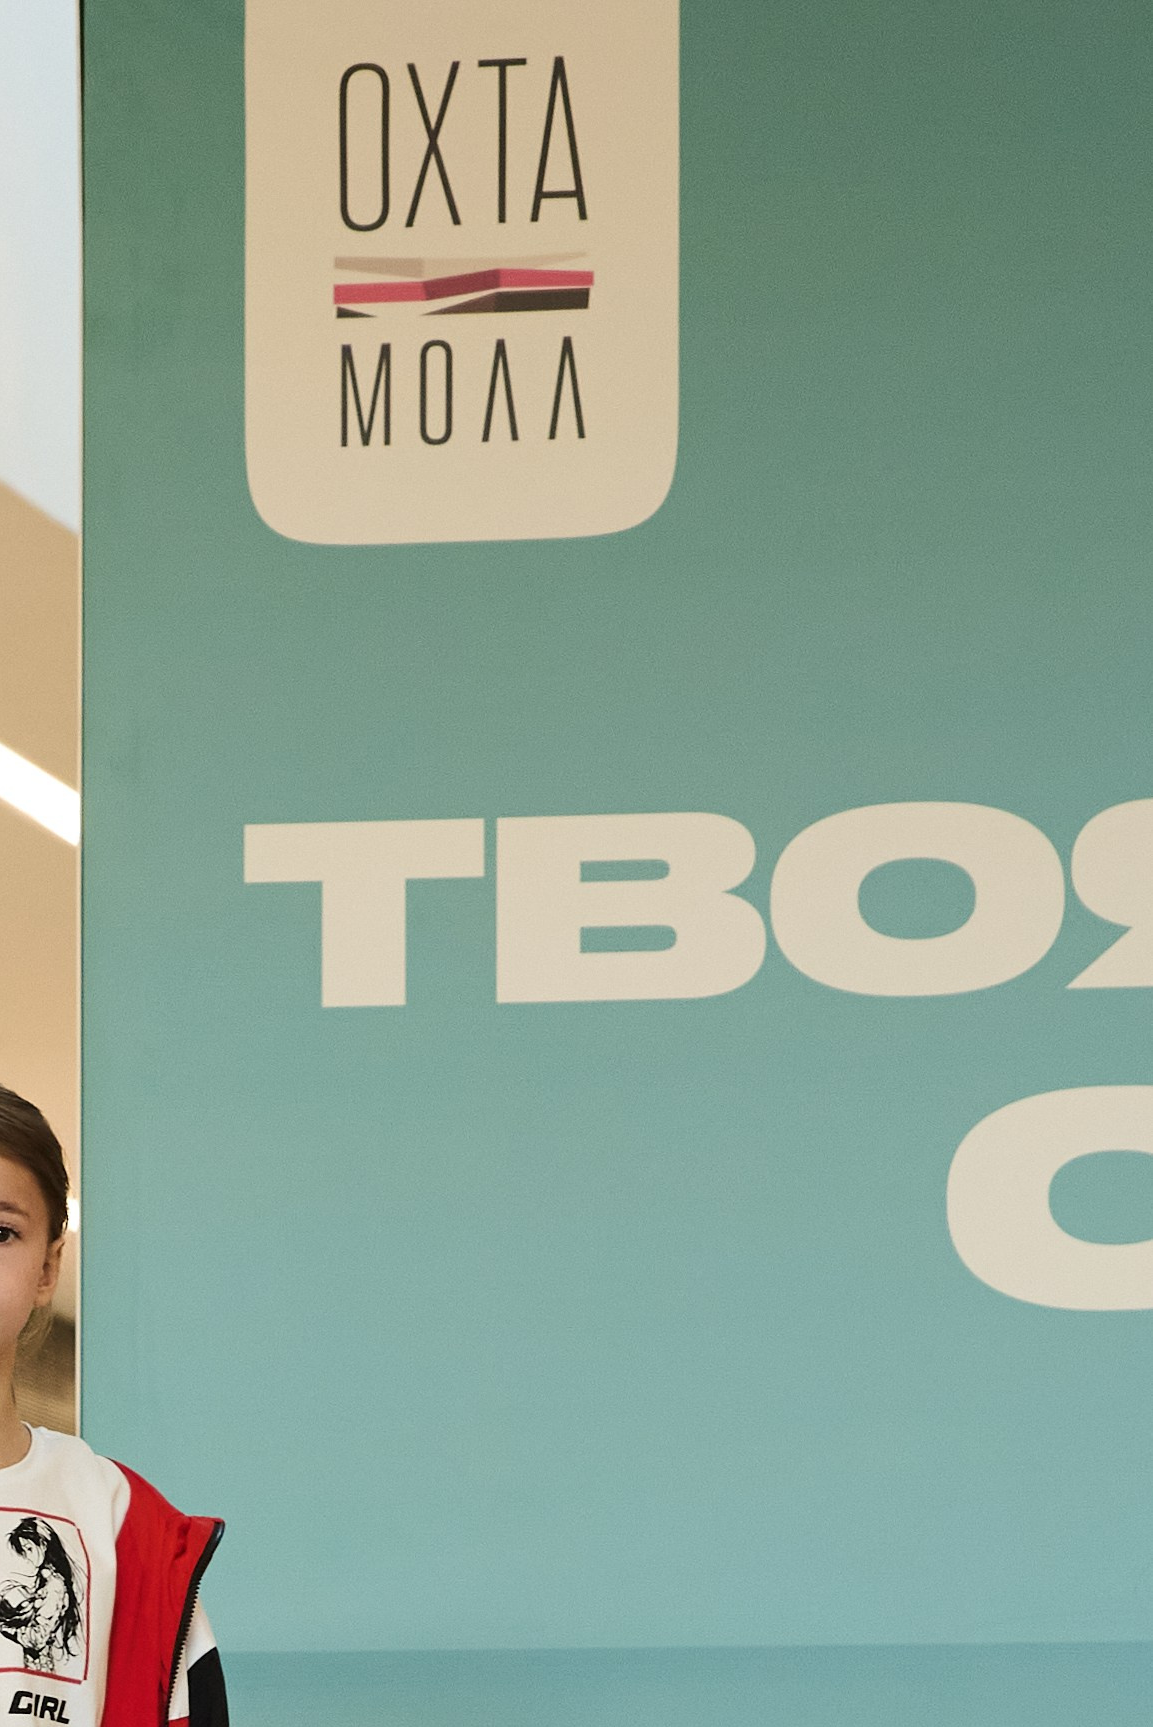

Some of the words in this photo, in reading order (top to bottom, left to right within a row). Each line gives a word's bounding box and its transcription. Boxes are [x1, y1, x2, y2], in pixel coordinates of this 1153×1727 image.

[339, 56, 588, 232] ОХТА
[341, 336, 586, 447] МОЛЛ
[8, 1690, 71, 1725] GIRL
